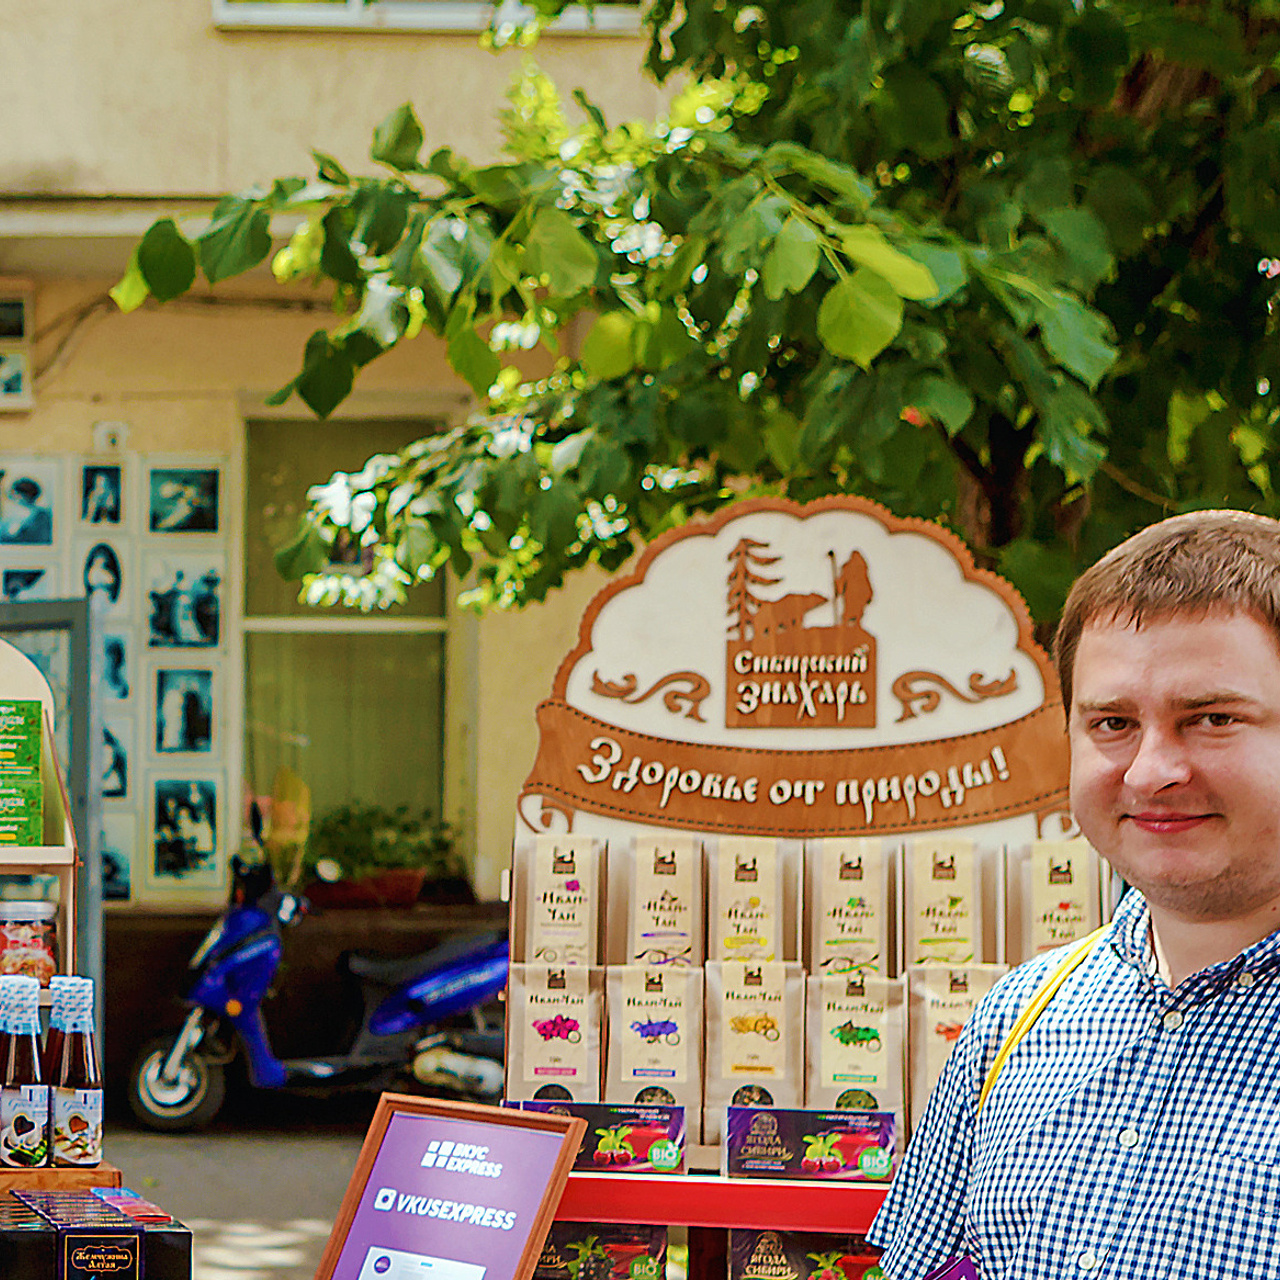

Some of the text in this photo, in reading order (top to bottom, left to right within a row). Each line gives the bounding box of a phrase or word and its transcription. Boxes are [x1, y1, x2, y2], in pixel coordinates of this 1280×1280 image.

[577, 736, 758, 808] Здоровье
[769, 779, 825, 806] от
[452, 1143, 489, 1160] ВКУС
[652, 1146, 677, 1161] BIO
[446, 1156, 503, 1178] EXPRESS
[862, 1153, 888, 1167] BIO
[396, 1193, 517, 1231] VKUSEXPRESS
[750, 1253, 788, 1266] ЯГОДА
[634, 1263, 658, 1277] BIO
[745, 1264, 792, 1279] СИБИРИ
